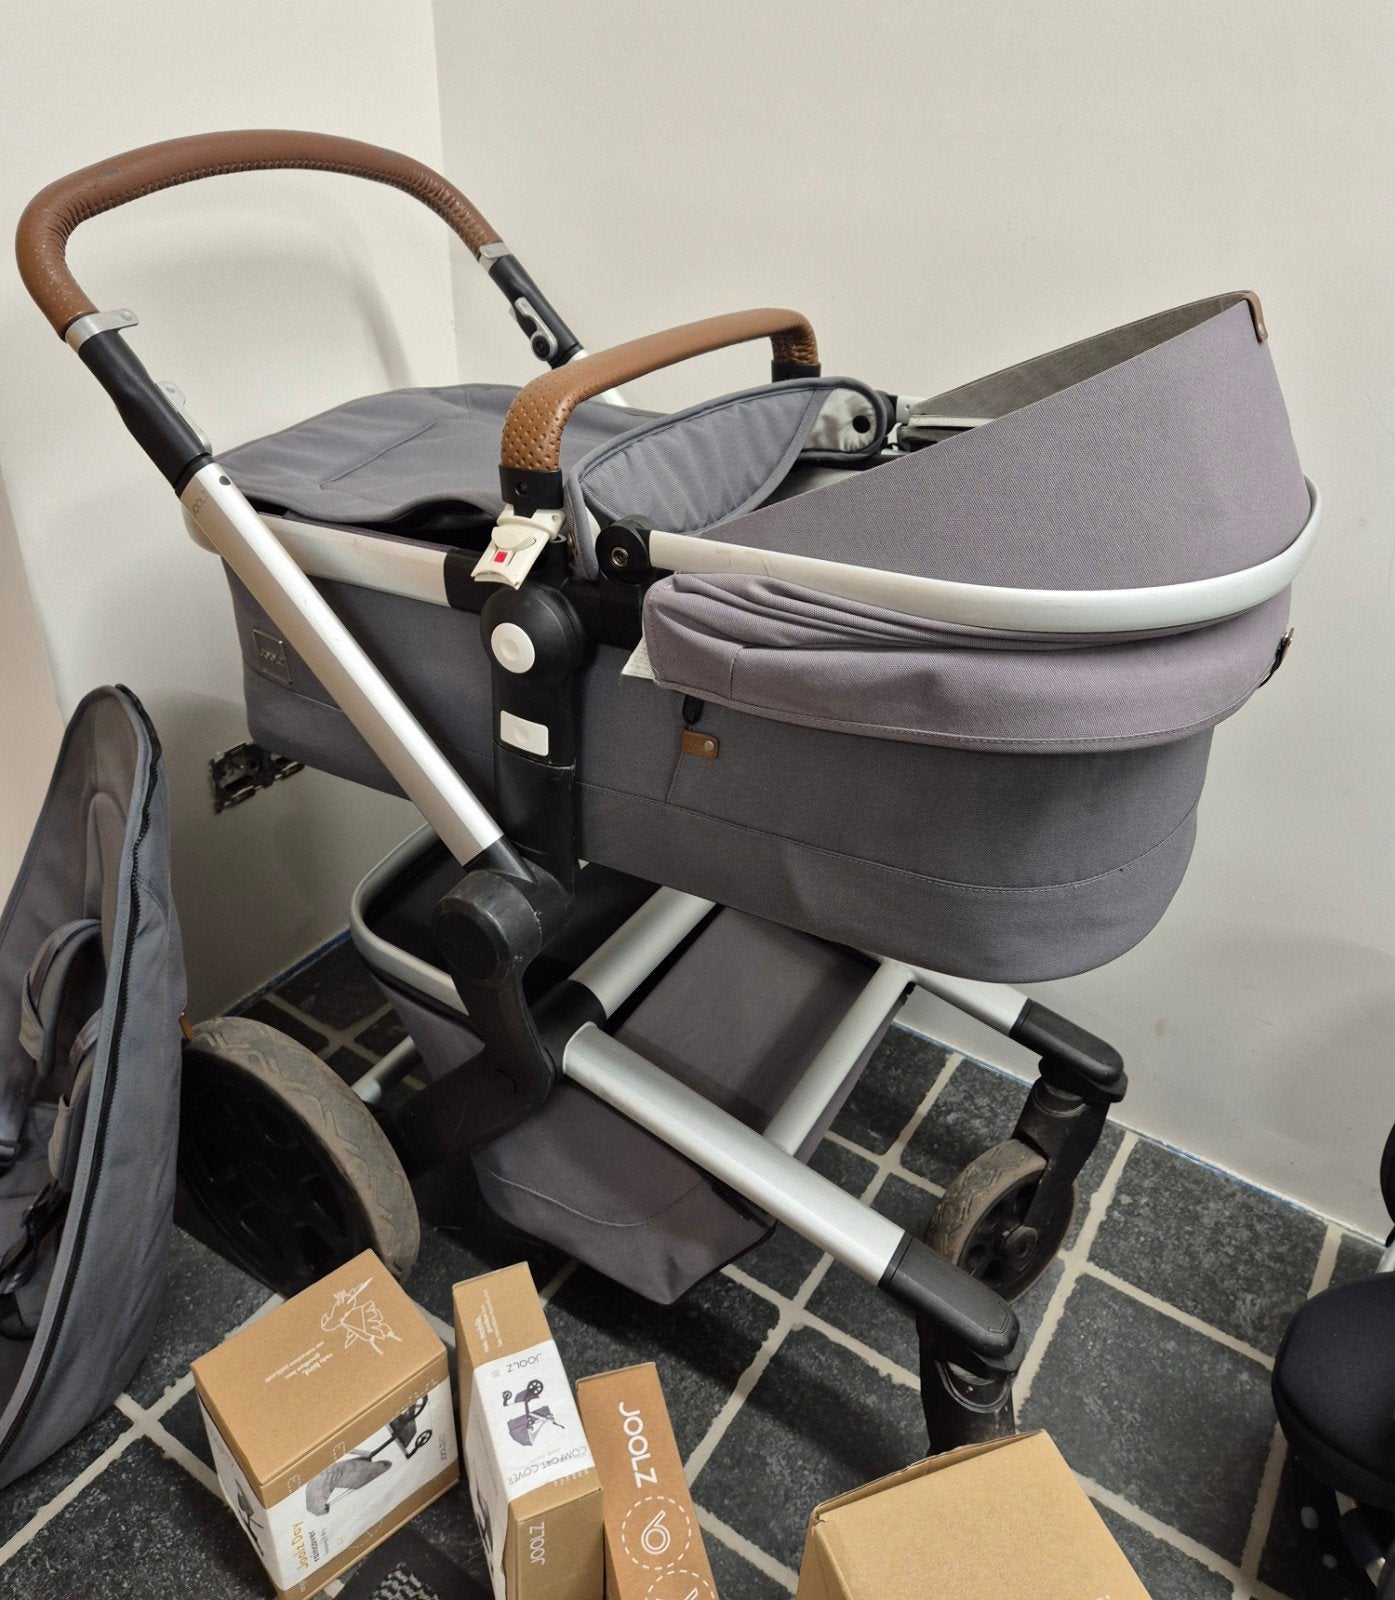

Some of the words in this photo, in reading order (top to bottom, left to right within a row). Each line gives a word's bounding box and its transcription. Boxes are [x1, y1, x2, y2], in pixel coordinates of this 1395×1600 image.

[505, 1352, 542, 1373] JOOLZ
[541, 1445, 587, 1469] COMFORT
[618, 1401, 658, 1489] JOOLZ
[507, 1464, 539, 1485] COVER
[291, 1521, 304, 1546] Day
[309, 1530, 320, 1562] raincover
[529, 1520, 546, 1566] JOOLZ
[293, 1542, 309, 1570] Joolz
